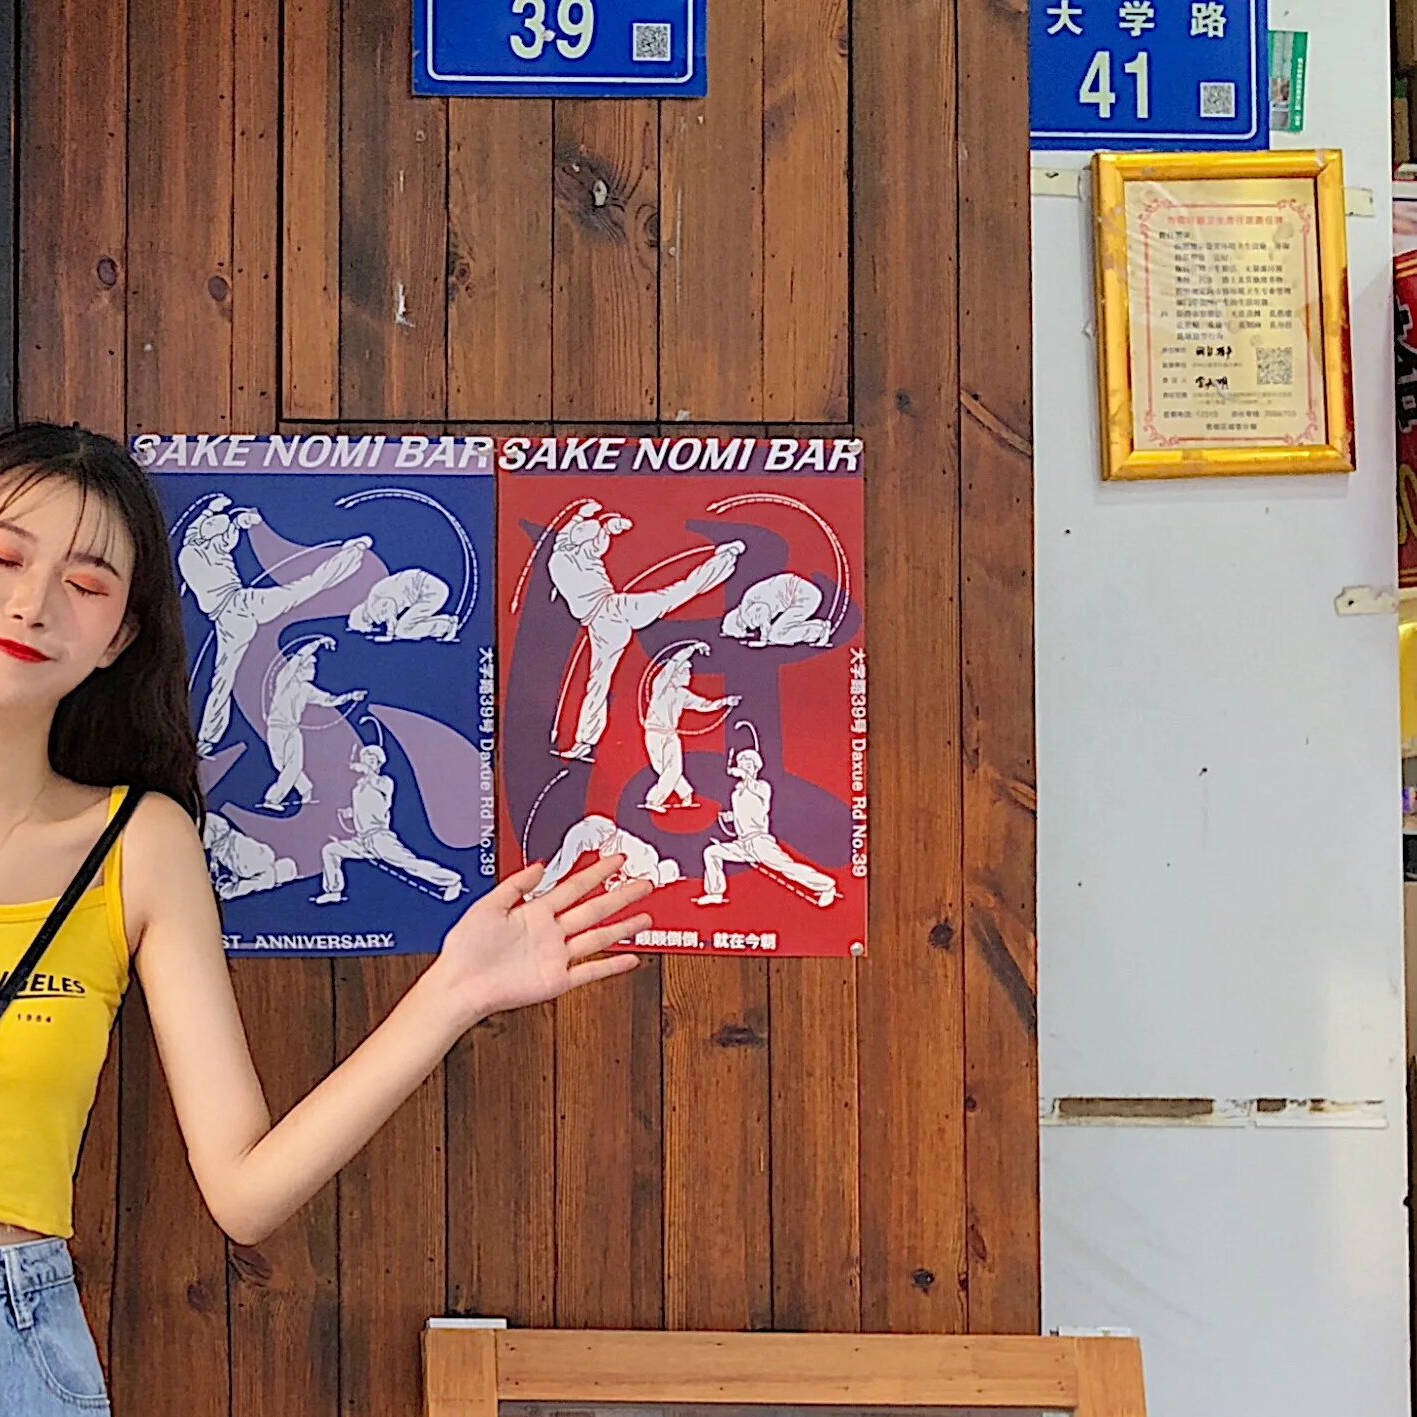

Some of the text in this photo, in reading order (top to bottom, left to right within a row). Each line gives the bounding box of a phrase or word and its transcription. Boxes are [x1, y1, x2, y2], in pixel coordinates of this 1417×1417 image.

[510, 0, 594, 59] 39
[1046, 2, 1227, 38] 大学路
[1079, 50, 1151, 119] 41
[134, 434, 494, 469] SAKE NOMI BAR
[498, 437, 864, 472] SAKE NOMI BAR
[480, 738, 495, 790] Daxue
[851, 738, 866, 791] Daxue
[480, 796, 495, 819] Rd
[851, 796, 867, 820] Rd
[480, 824, 495, 876] No.39
[851, 824, 867, 877] No.39
[254, 933, 394, 949] ANNIVERSARY
